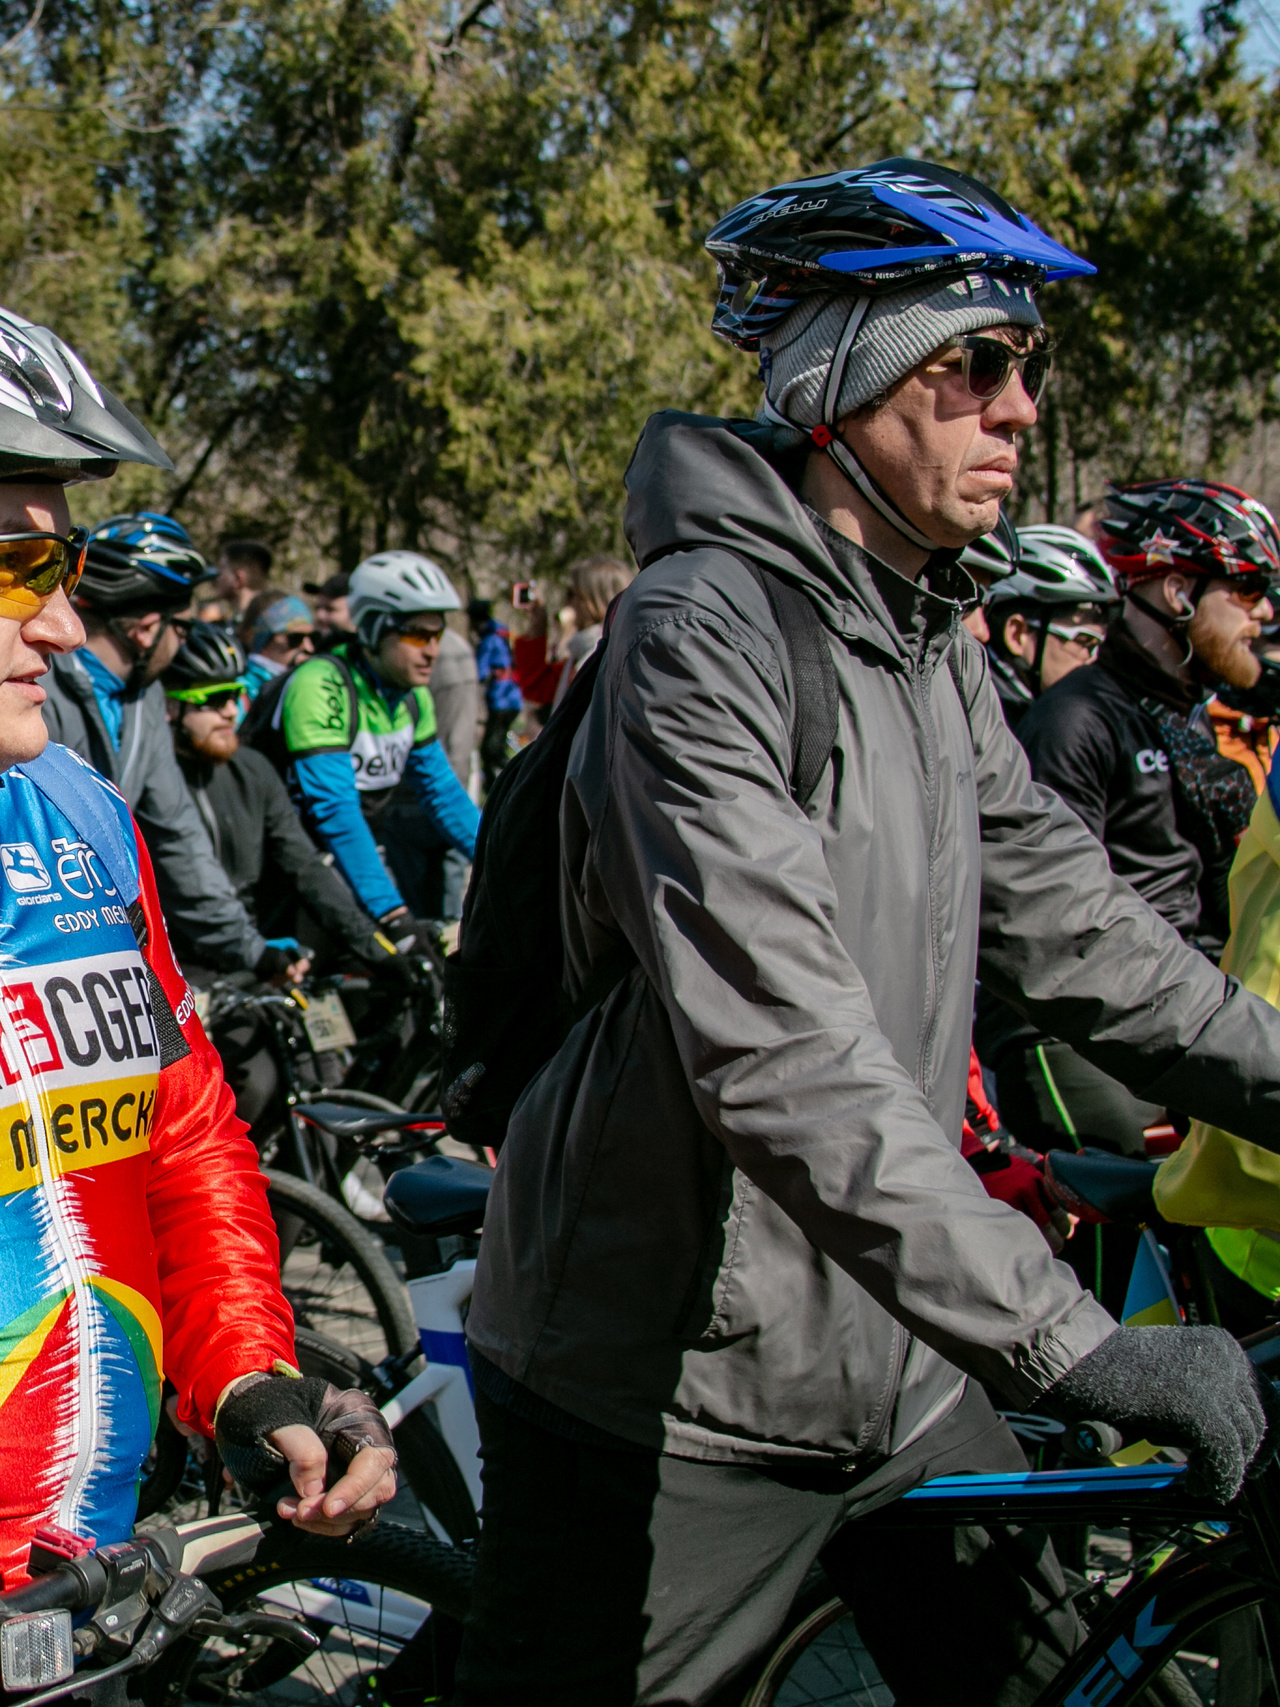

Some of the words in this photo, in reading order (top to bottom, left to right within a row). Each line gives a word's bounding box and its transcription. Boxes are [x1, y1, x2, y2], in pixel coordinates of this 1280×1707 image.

[749, 199, 828, 227] SPELLI
[875, 268, 913, 280] NiteSafe
[53, 908, 100, 934] EDDY
[10, 1088, 159, 1172] MERCK
